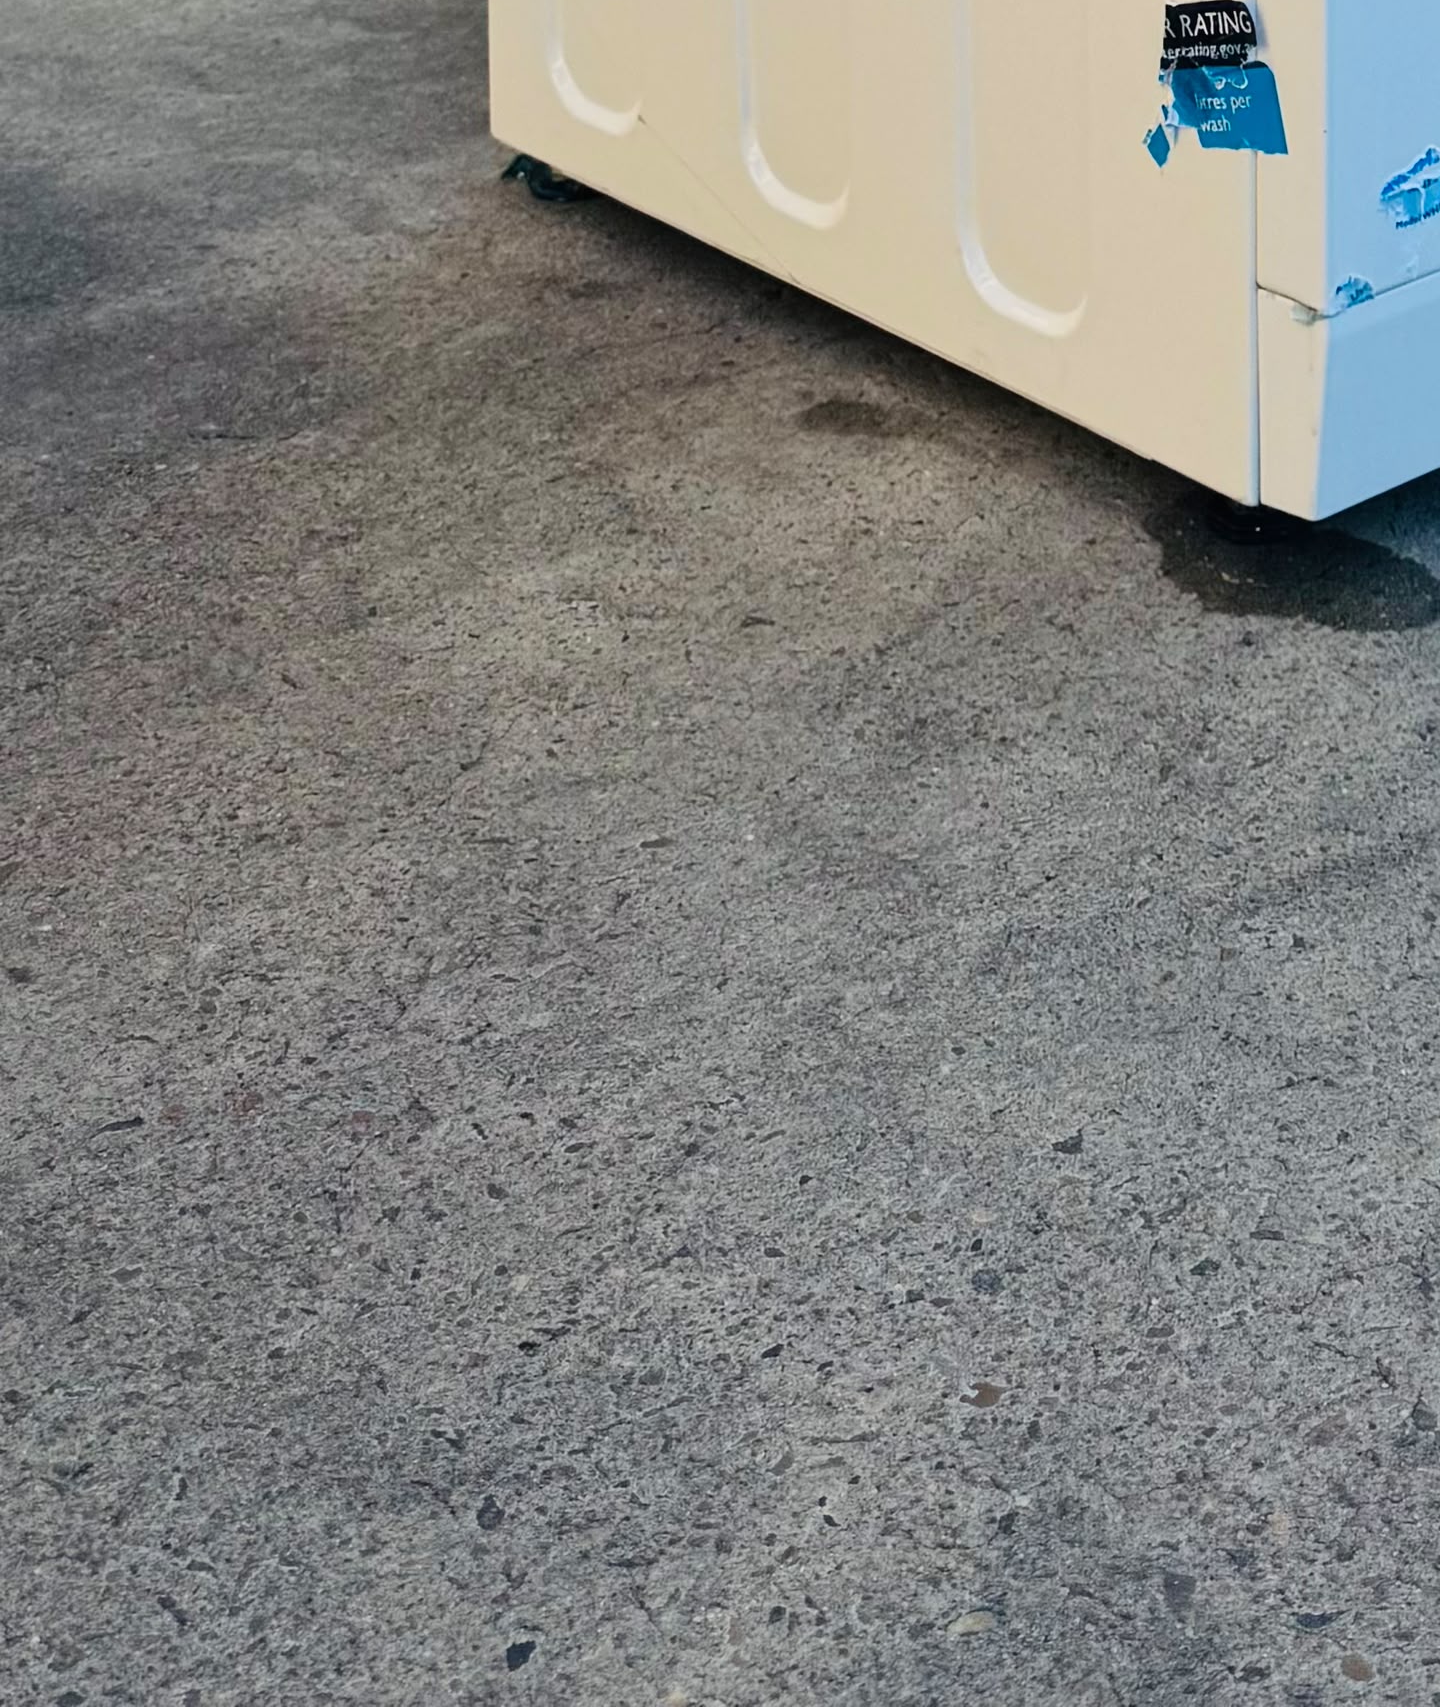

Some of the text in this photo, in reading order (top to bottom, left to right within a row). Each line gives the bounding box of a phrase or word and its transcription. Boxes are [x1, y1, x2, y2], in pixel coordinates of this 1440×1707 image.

[1178, 10, 1252, 39] RATING
[1230, 95, 1252, 115] per
[1200, 114, 1232, 132] wash
